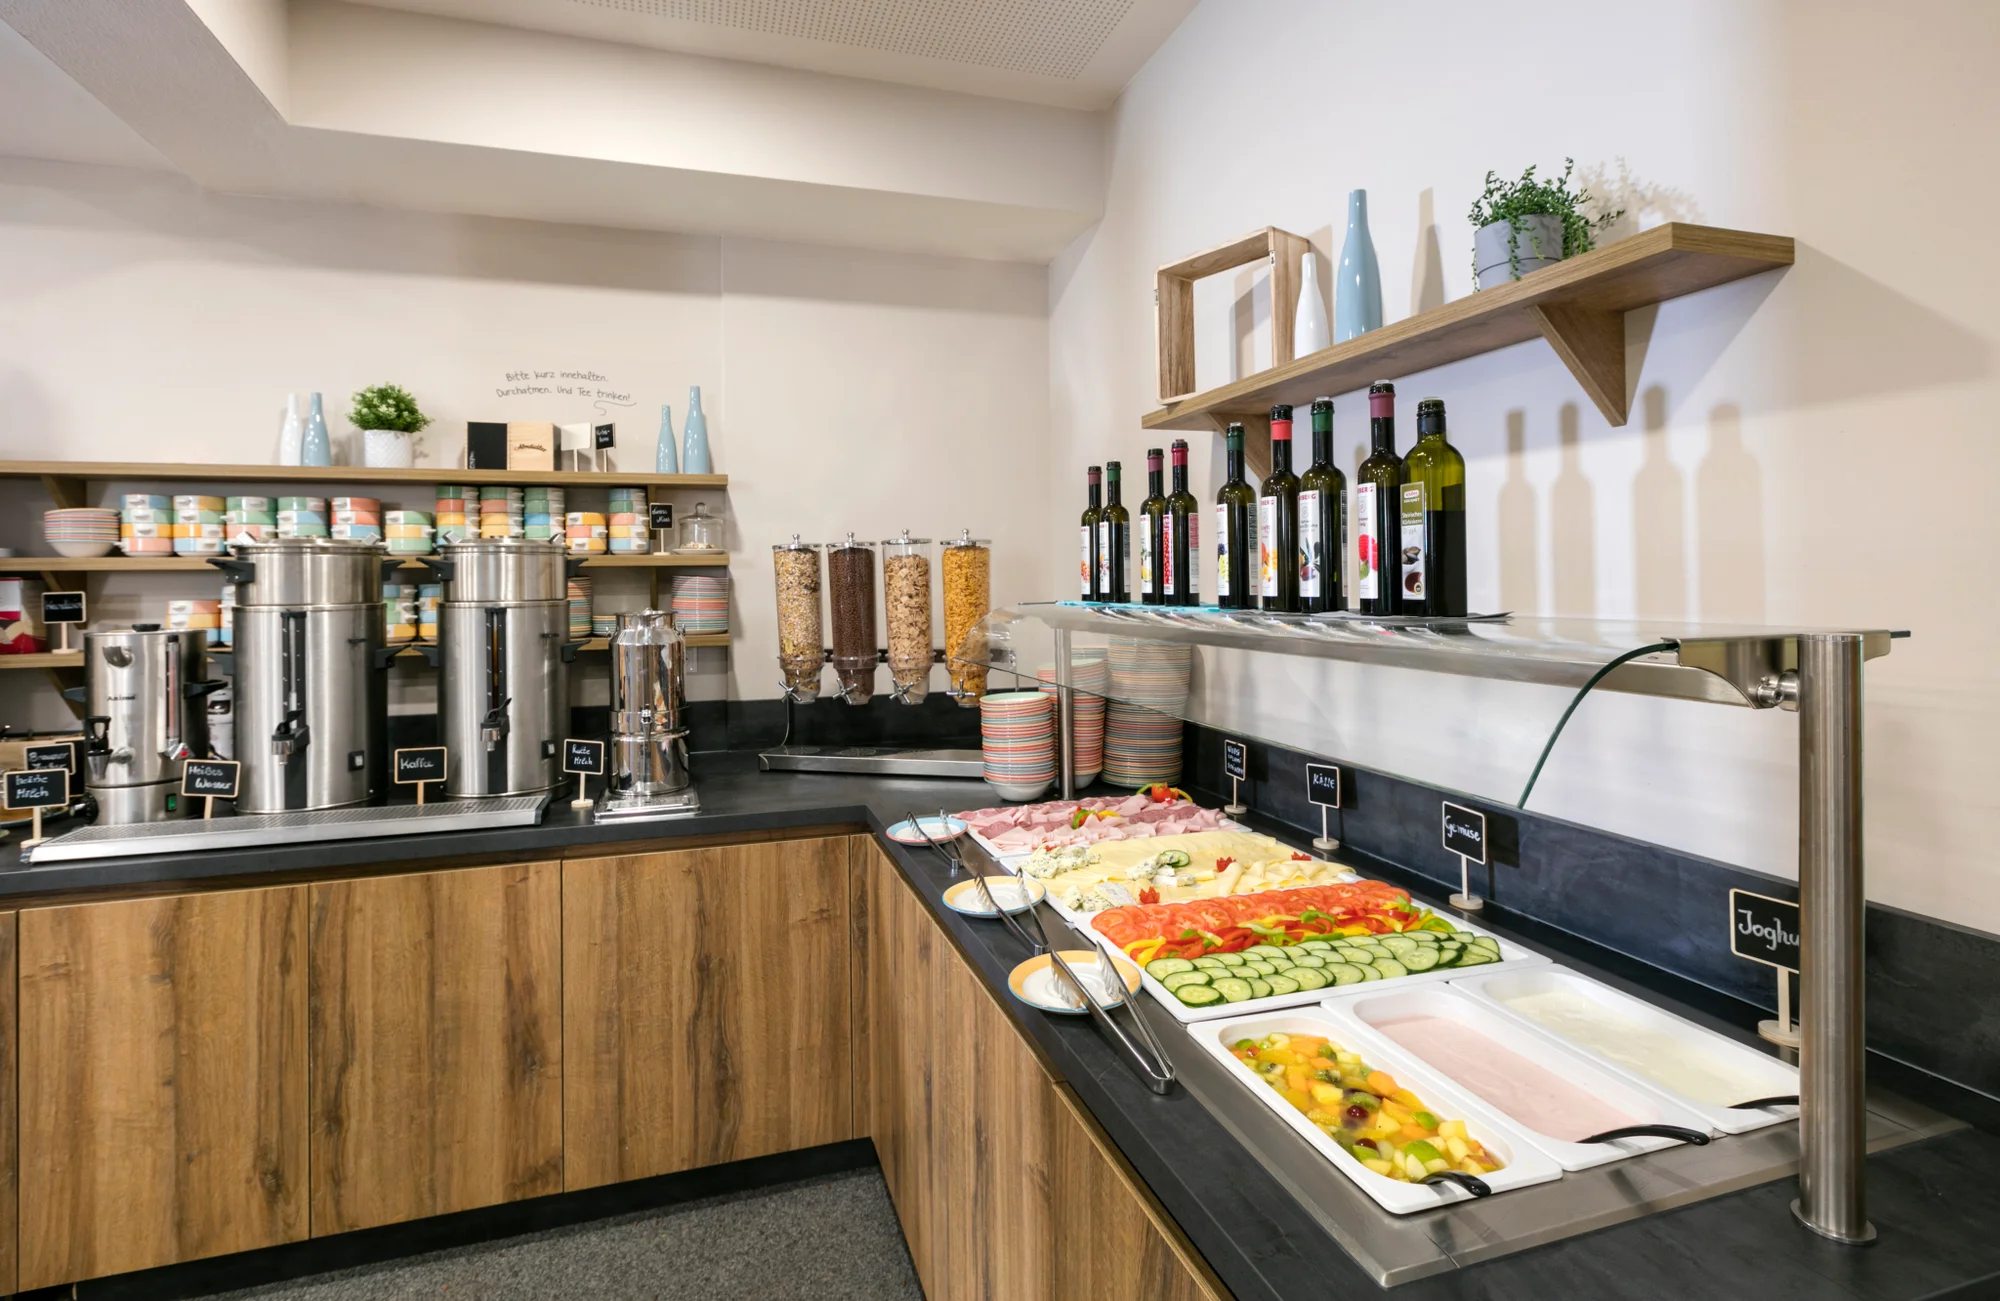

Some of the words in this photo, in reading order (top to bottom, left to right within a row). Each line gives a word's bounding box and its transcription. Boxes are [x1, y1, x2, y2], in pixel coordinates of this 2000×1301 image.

[505, 370, 531, 382] Bitte
[533, 370, 556, 380] kurz
[559, 370, 609, 382] innehalten.
[495, 385, 552, 398] Durchatmen.
[556, 386, 573, 395] Und
[576, 387, 592, 397] Tee
[596, 388, 631, 402] trinken!
[573, 755, 593, 766] Milch
[194, 777, 233, 790] Wasser
[15, 786, 49, 799] Milch
[1444, 815, 1481, 842] Gemüse
[1737, 908, 1800, 951] Joghu
